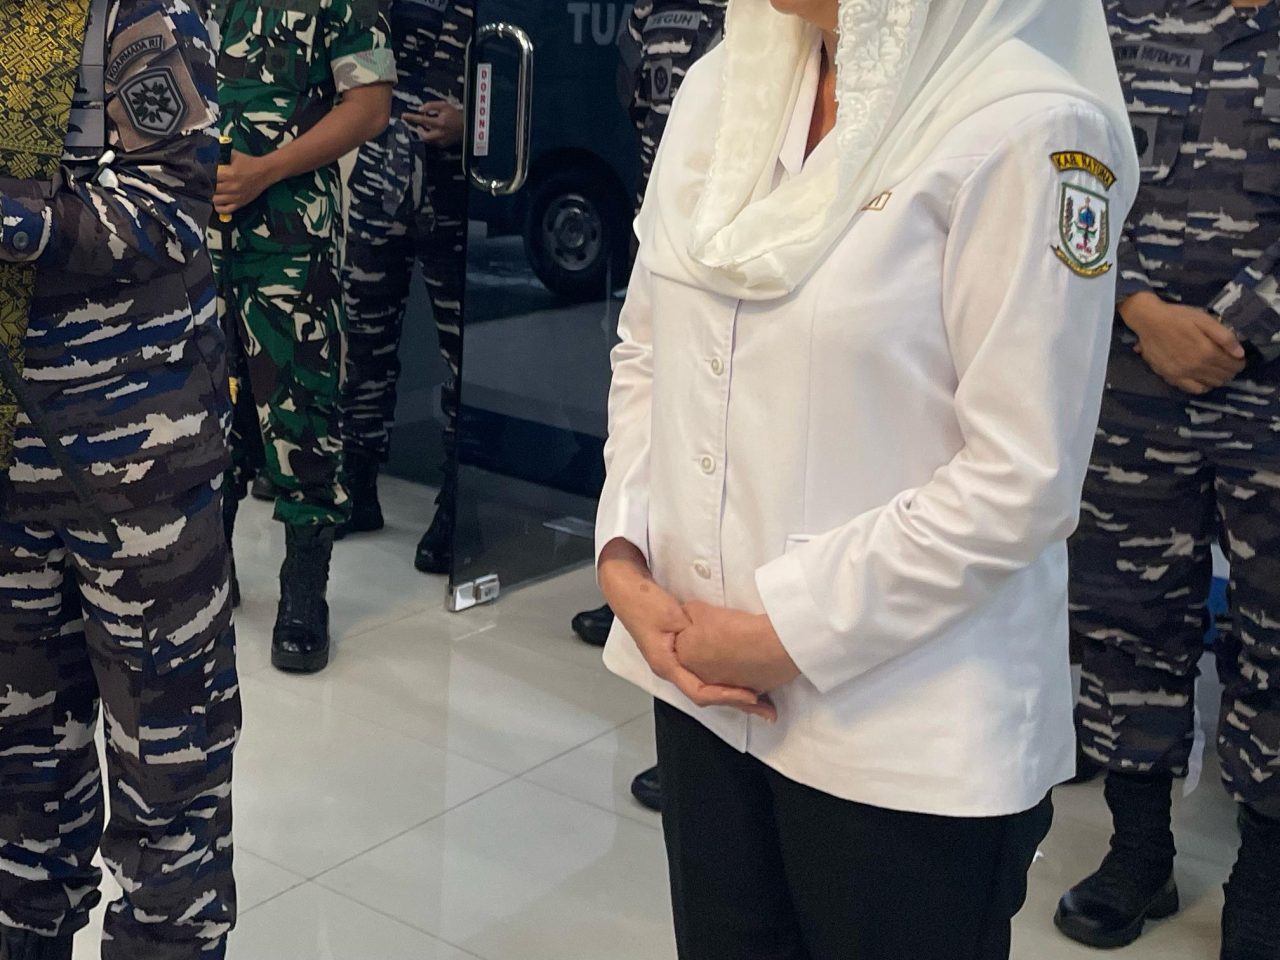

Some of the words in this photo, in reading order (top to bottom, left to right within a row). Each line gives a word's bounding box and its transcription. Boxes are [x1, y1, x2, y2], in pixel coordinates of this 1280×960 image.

[108, 40, 148, 80] KOARMADA
[148, 37, 160, 49] RI
[478, 70, 487, 140] DORONG
